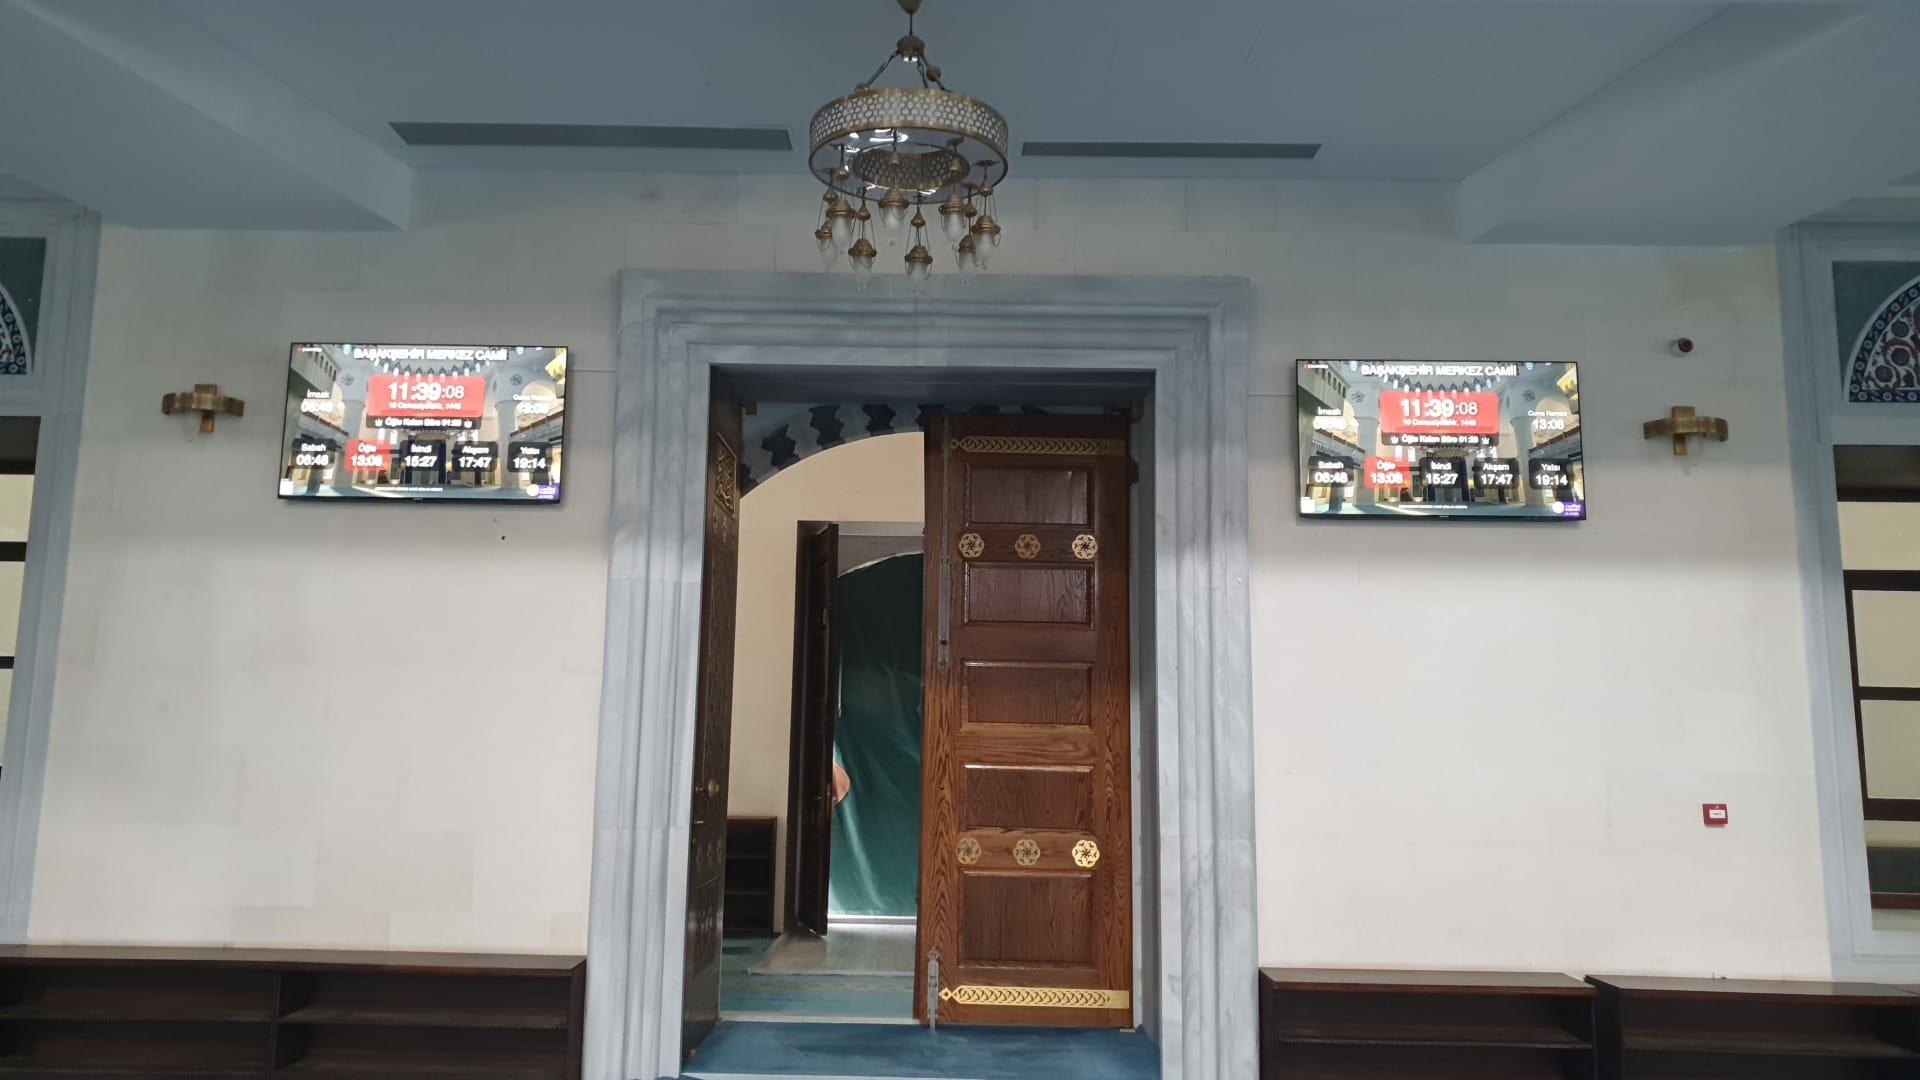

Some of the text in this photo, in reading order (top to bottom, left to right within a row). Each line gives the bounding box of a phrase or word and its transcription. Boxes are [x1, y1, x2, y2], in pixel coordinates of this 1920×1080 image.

[426, 348, 474, 360] MERKEZ
[1361, 364, 1434, 378] BAŞAKŞEHİR
[1435, 365, 1484, 376] MERKEZ
[388, 381, 465, 401] 11:39:08
[1400, 398, 1479, 418] 11:39:08
[1480, 474, 1514, 486] 17:47
[1535, 474, 1569, 486] 19:14
